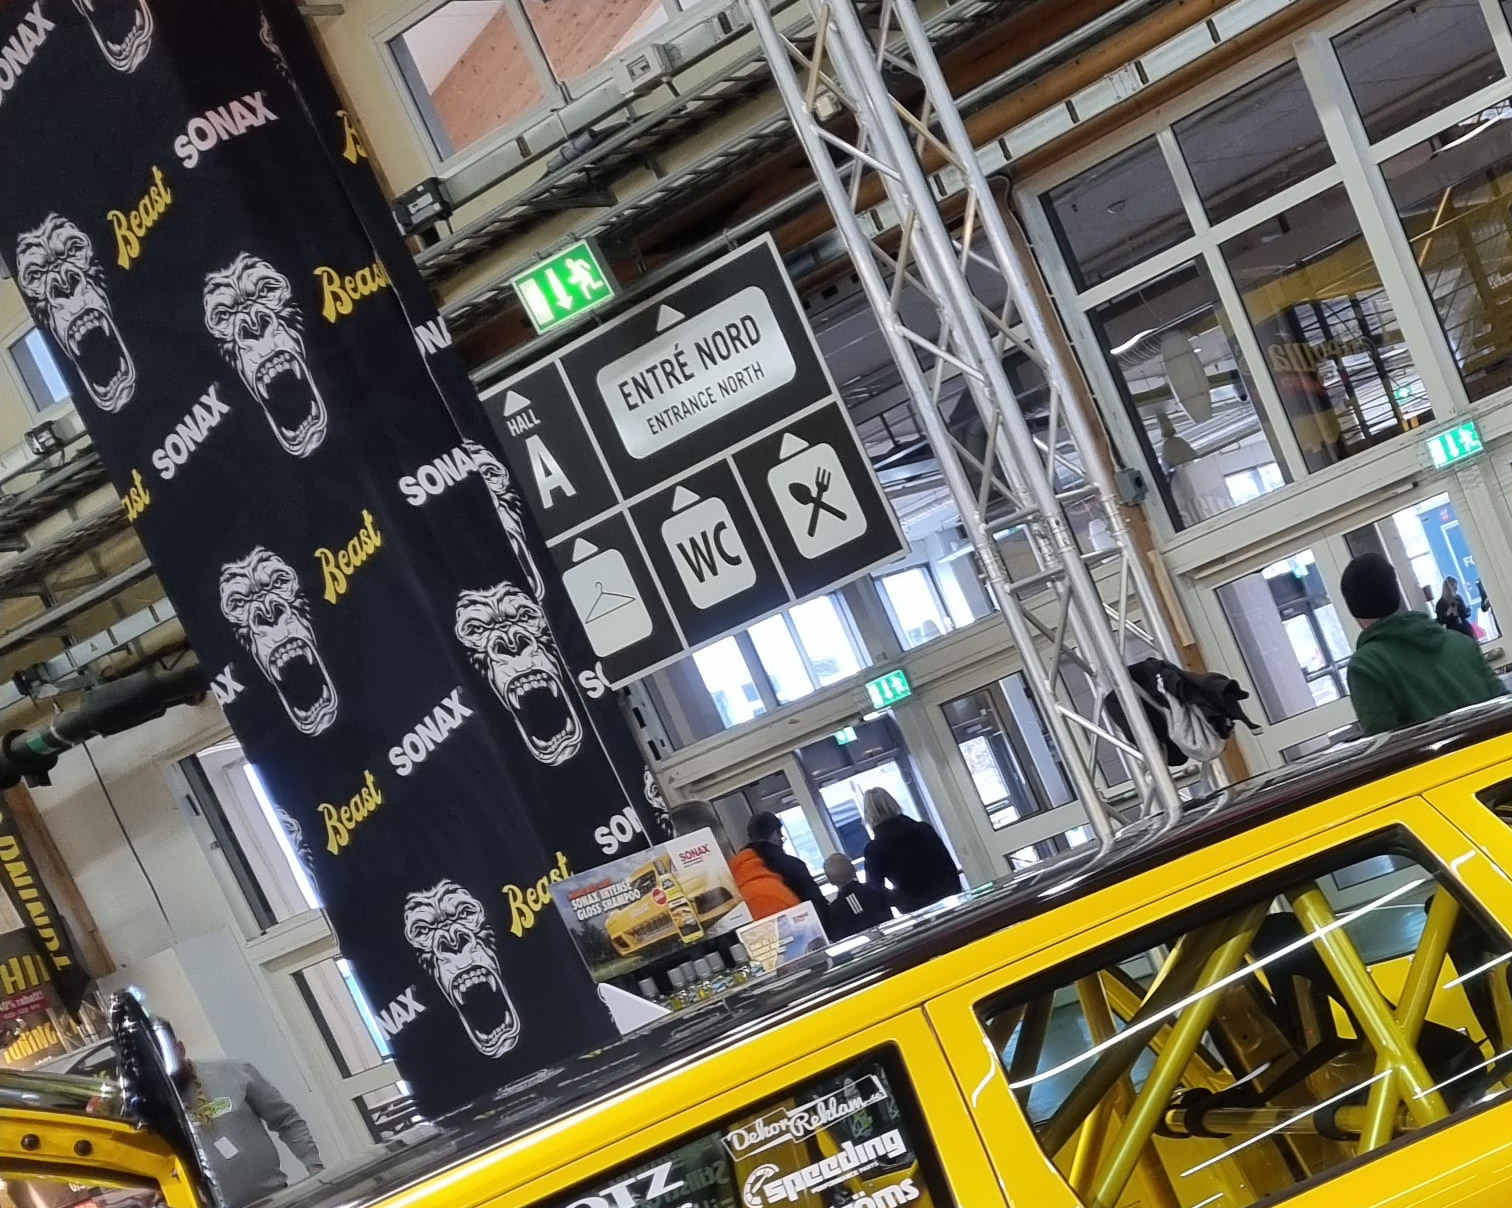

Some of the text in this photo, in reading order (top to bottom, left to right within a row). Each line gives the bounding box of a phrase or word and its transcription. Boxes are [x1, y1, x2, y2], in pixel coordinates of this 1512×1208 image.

[0, 1, 56, 98] ONAX
[174, 91, 279, 169] SONAX
[106, 165, 172, 270] Beast
[616, 312, 762, 412] ENTRÉ NORD
[646, 361, 766, 436] ENTRANCE NORTH
[152, 384, 232, 480] SONAX
[506, 408, 541, 438] HALL
[398, 447, 480, 507] SONA
[525, 433, 578, 509] A
[314, 509, 383, 605] Beast
[676, 520, 743, 585] WC
[388, 690, 474, 777] SONAX
[318, 769, 383, 856] Beast
[594, 806, 644, 856] SON
[678, 844, 711, 862] SONAX
[571, 890, 600, 911] SONAX
[600, 879, 633, 903] INTENSE
[576, 904, 602, 921] GLOSS
[603, 888, 641, 912] SHAMPOO
[3, 1021, 59, 1064] TUNING
[375, 988, 427, 1042] NAX
[763, 1128, 907, 1204] speeding
